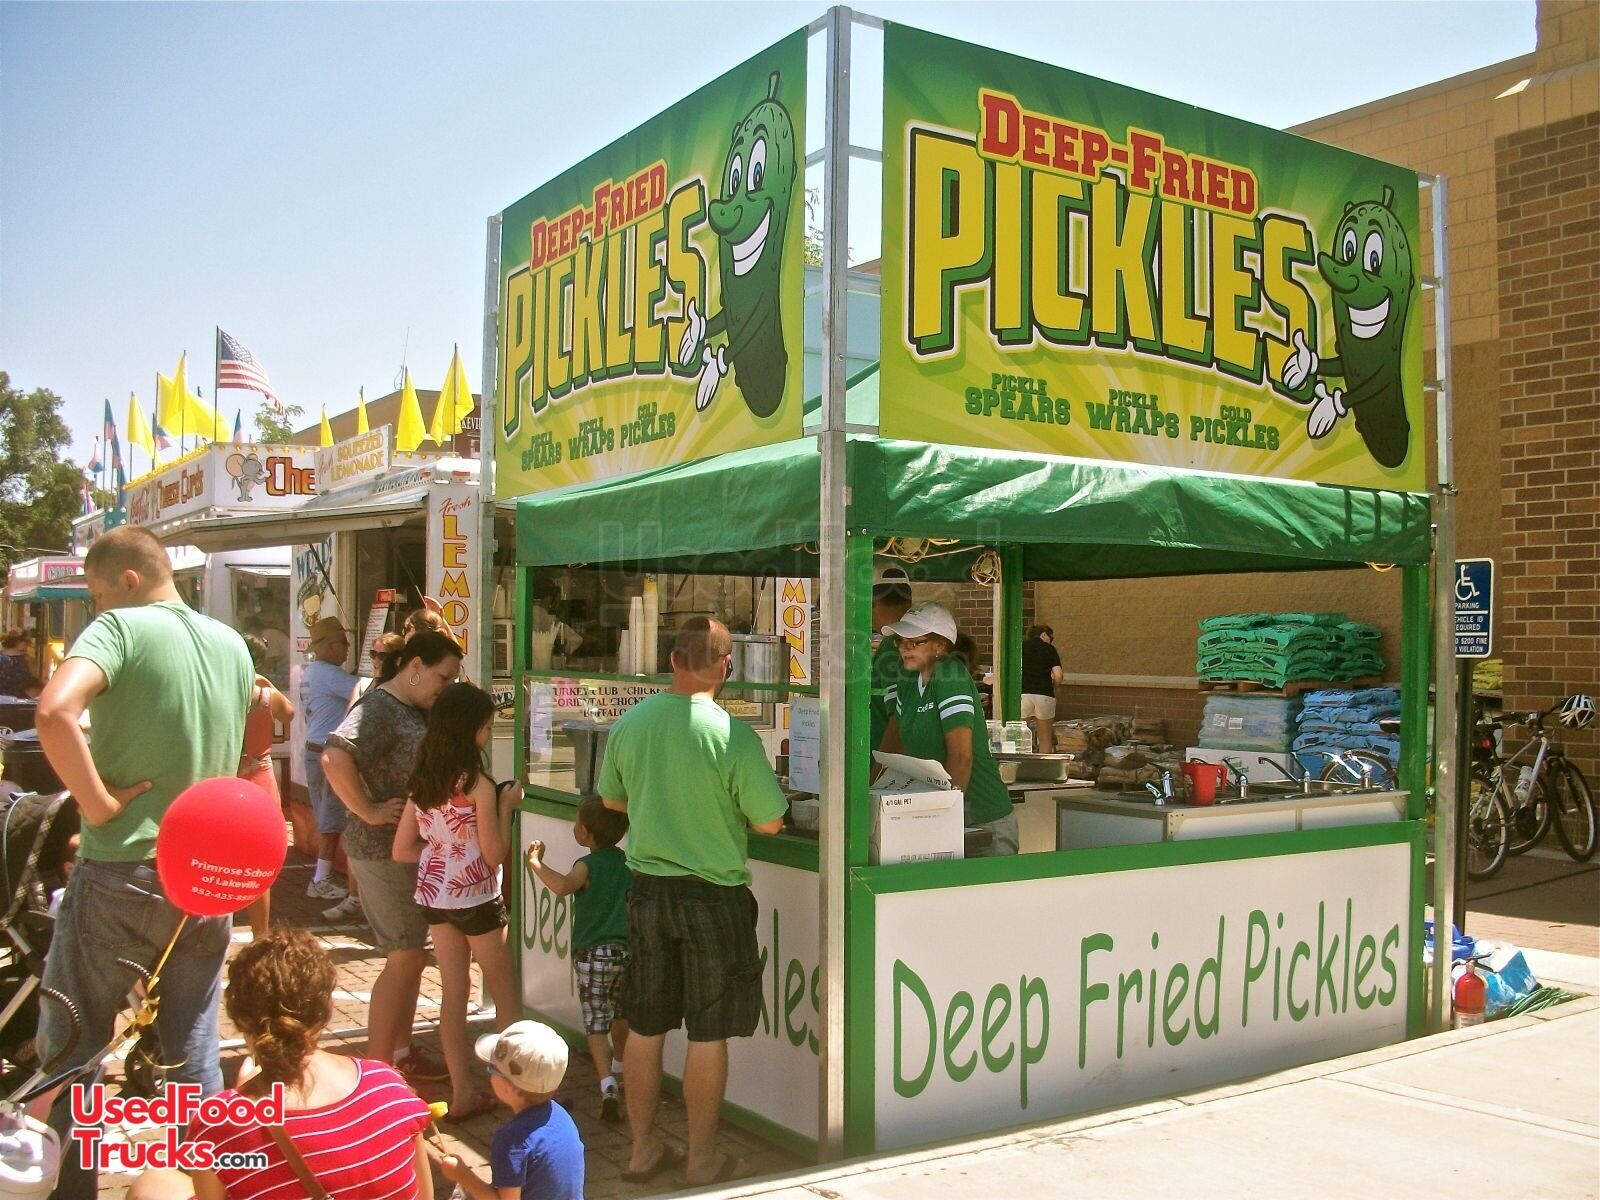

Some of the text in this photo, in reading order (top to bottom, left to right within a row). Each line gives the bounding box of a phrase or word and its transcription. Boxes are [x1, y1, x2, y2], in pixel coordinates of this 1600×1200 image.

[981, 92, 1256, 217] DEEP-FRIED
[531, 162, 667, 266] DEEP-FRIED
[909, 128, 1317, 402] PICKLES
[504, 180, 708, 435] PICKLES
[991, 372, 1048, 396] PICKLE
[1108, 388, 1159, 412] PICKLE
[637, 401, 657, 419] COLD
[965, 386, 1070, 426] SPEARS
[1086, 401, 1180, 439] WRAPS
[1219, 404, 1252, 424] COLD
[530, 430, 553, 450] PICKLE
[568, 426, 615, 461] WRAPS
[578, 416, 604, 435] PICKLE
[620, 411, 676, 448] PICKLES
[1190, 411, 1280, 451] PICKLES
[521, 440, 562, 472] SPEARS
[265, 456, 316, 496] Che
[439, 495, 472, 518] Fresh
[439, 514, 471, 656] LEMON
[191, 858, 276, 878] Primrose School
[215, 877, 261, 889] Lakeville
[891, 896, 1401, 1110] Deep Fried Pickles
